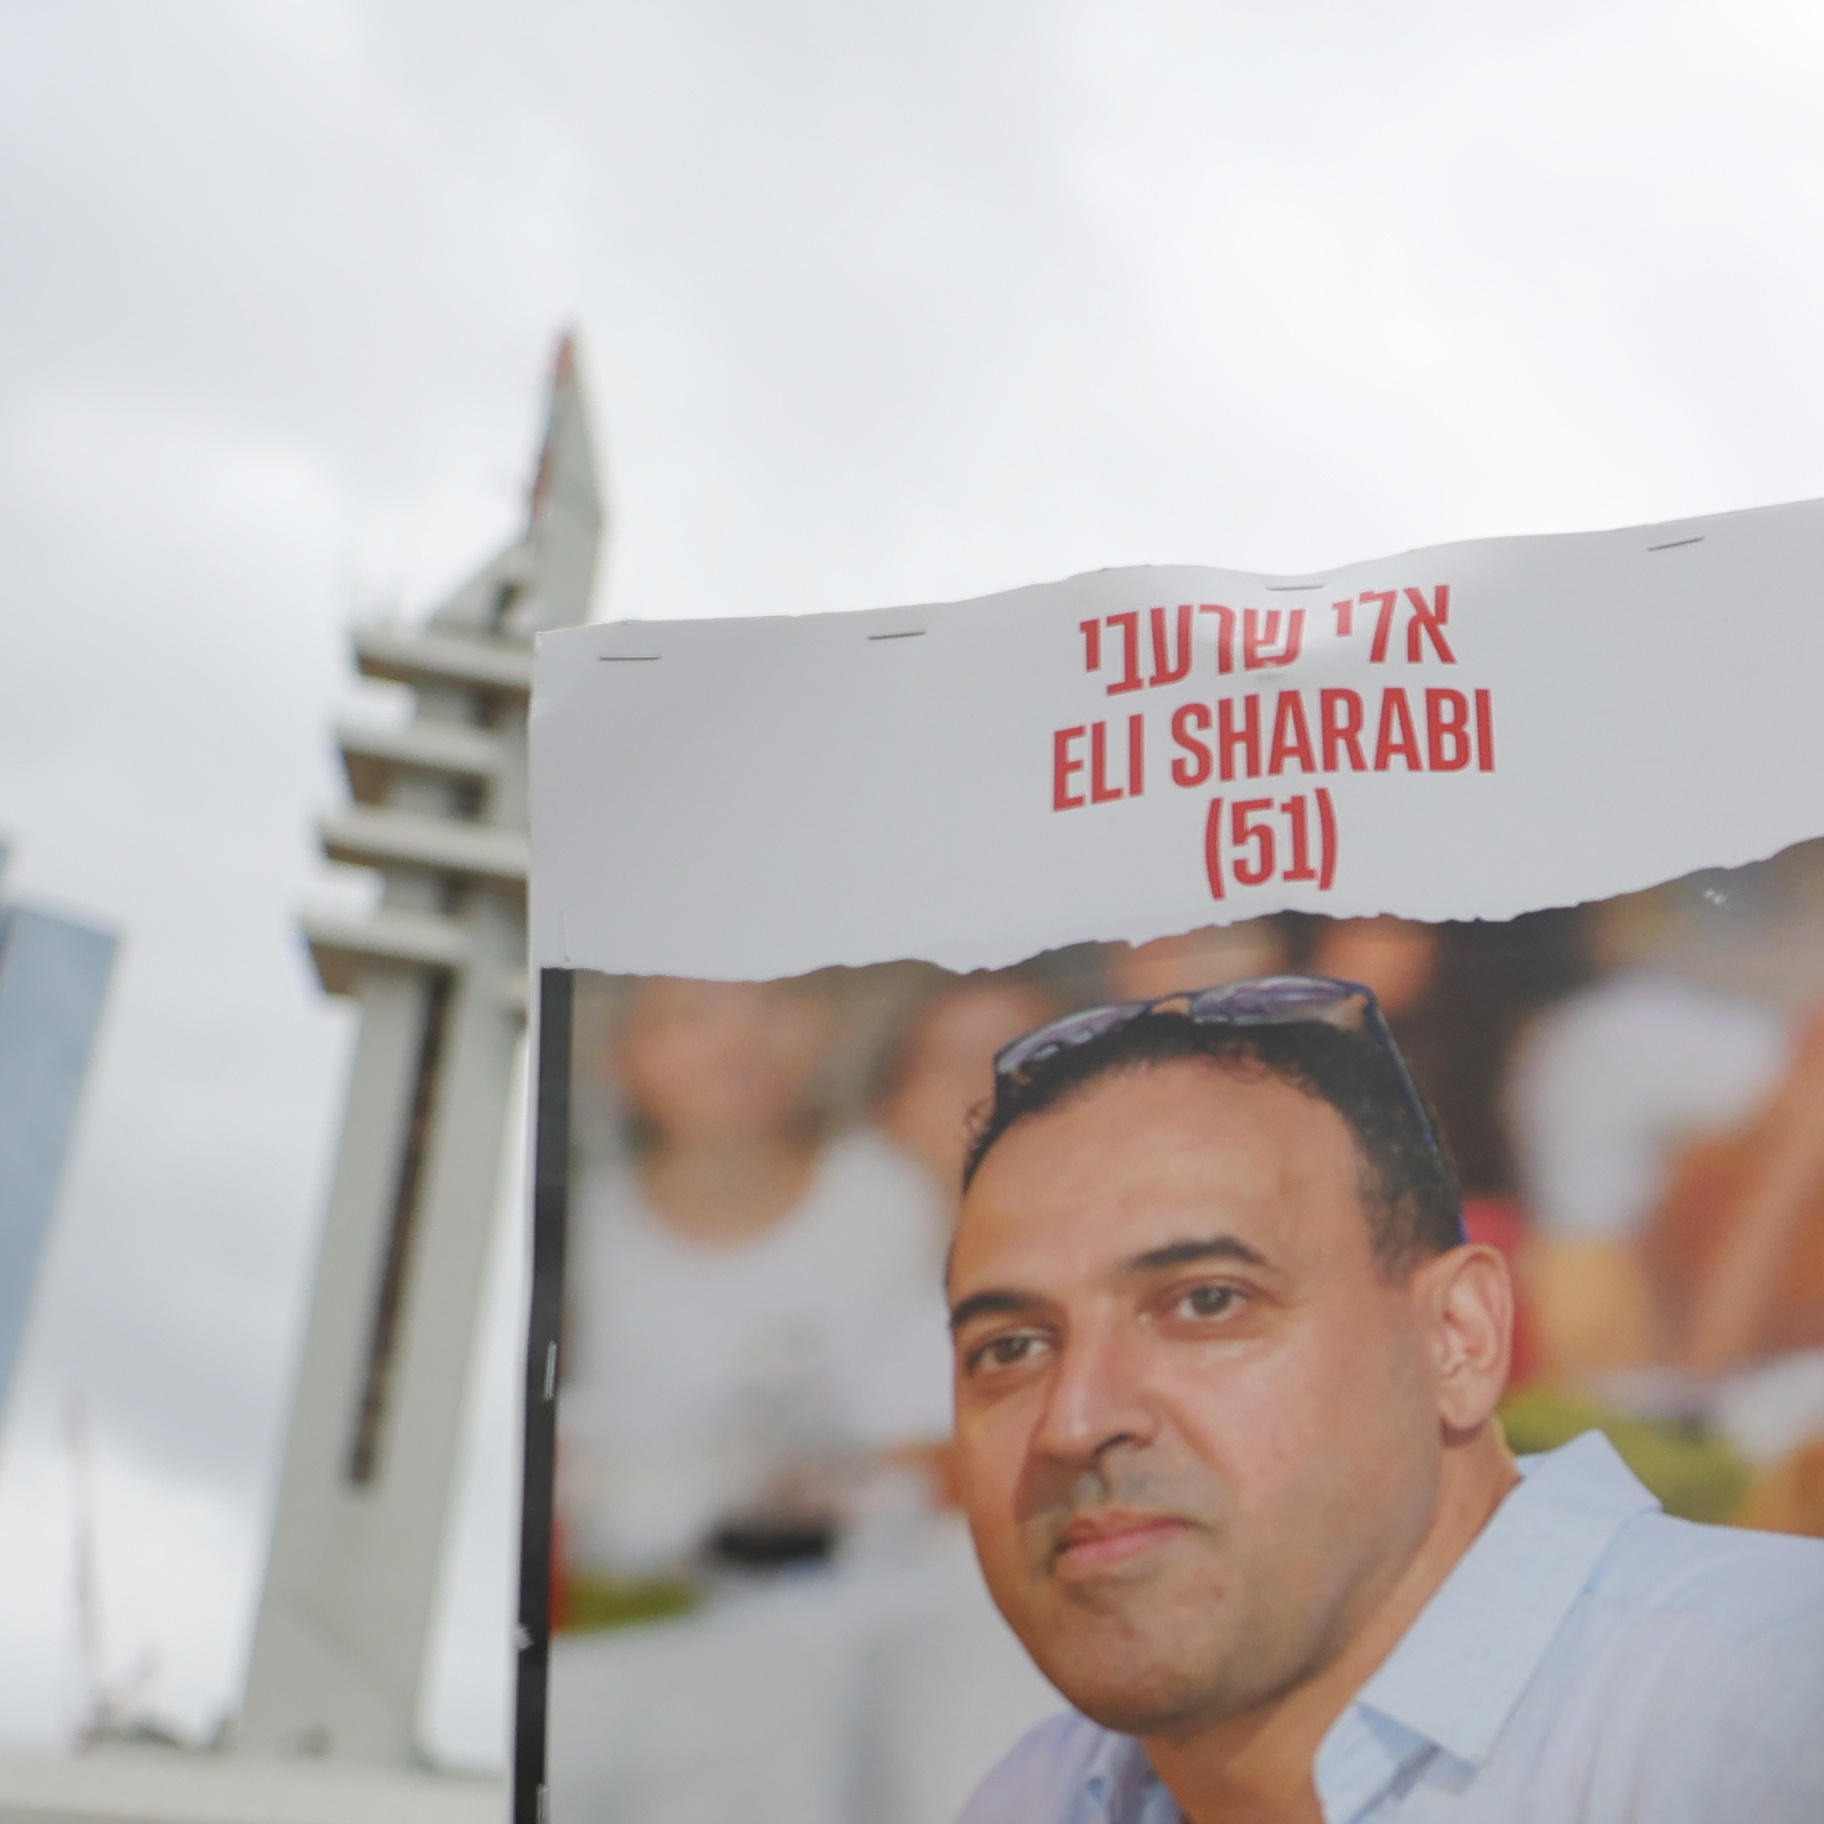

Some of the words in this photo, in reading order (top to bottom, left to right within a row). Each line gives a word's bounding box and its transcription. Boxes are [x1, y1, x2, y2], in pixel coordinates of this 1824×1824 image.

[1079, 603, 1306, 697] שרעבי
[1332, 583, 1457, 665] אלי
[1052, 713, 1144, 812] ELI
[1169, 686, 1495, 789] SHARABI
[1203, 787, 1338, 901] (51)
